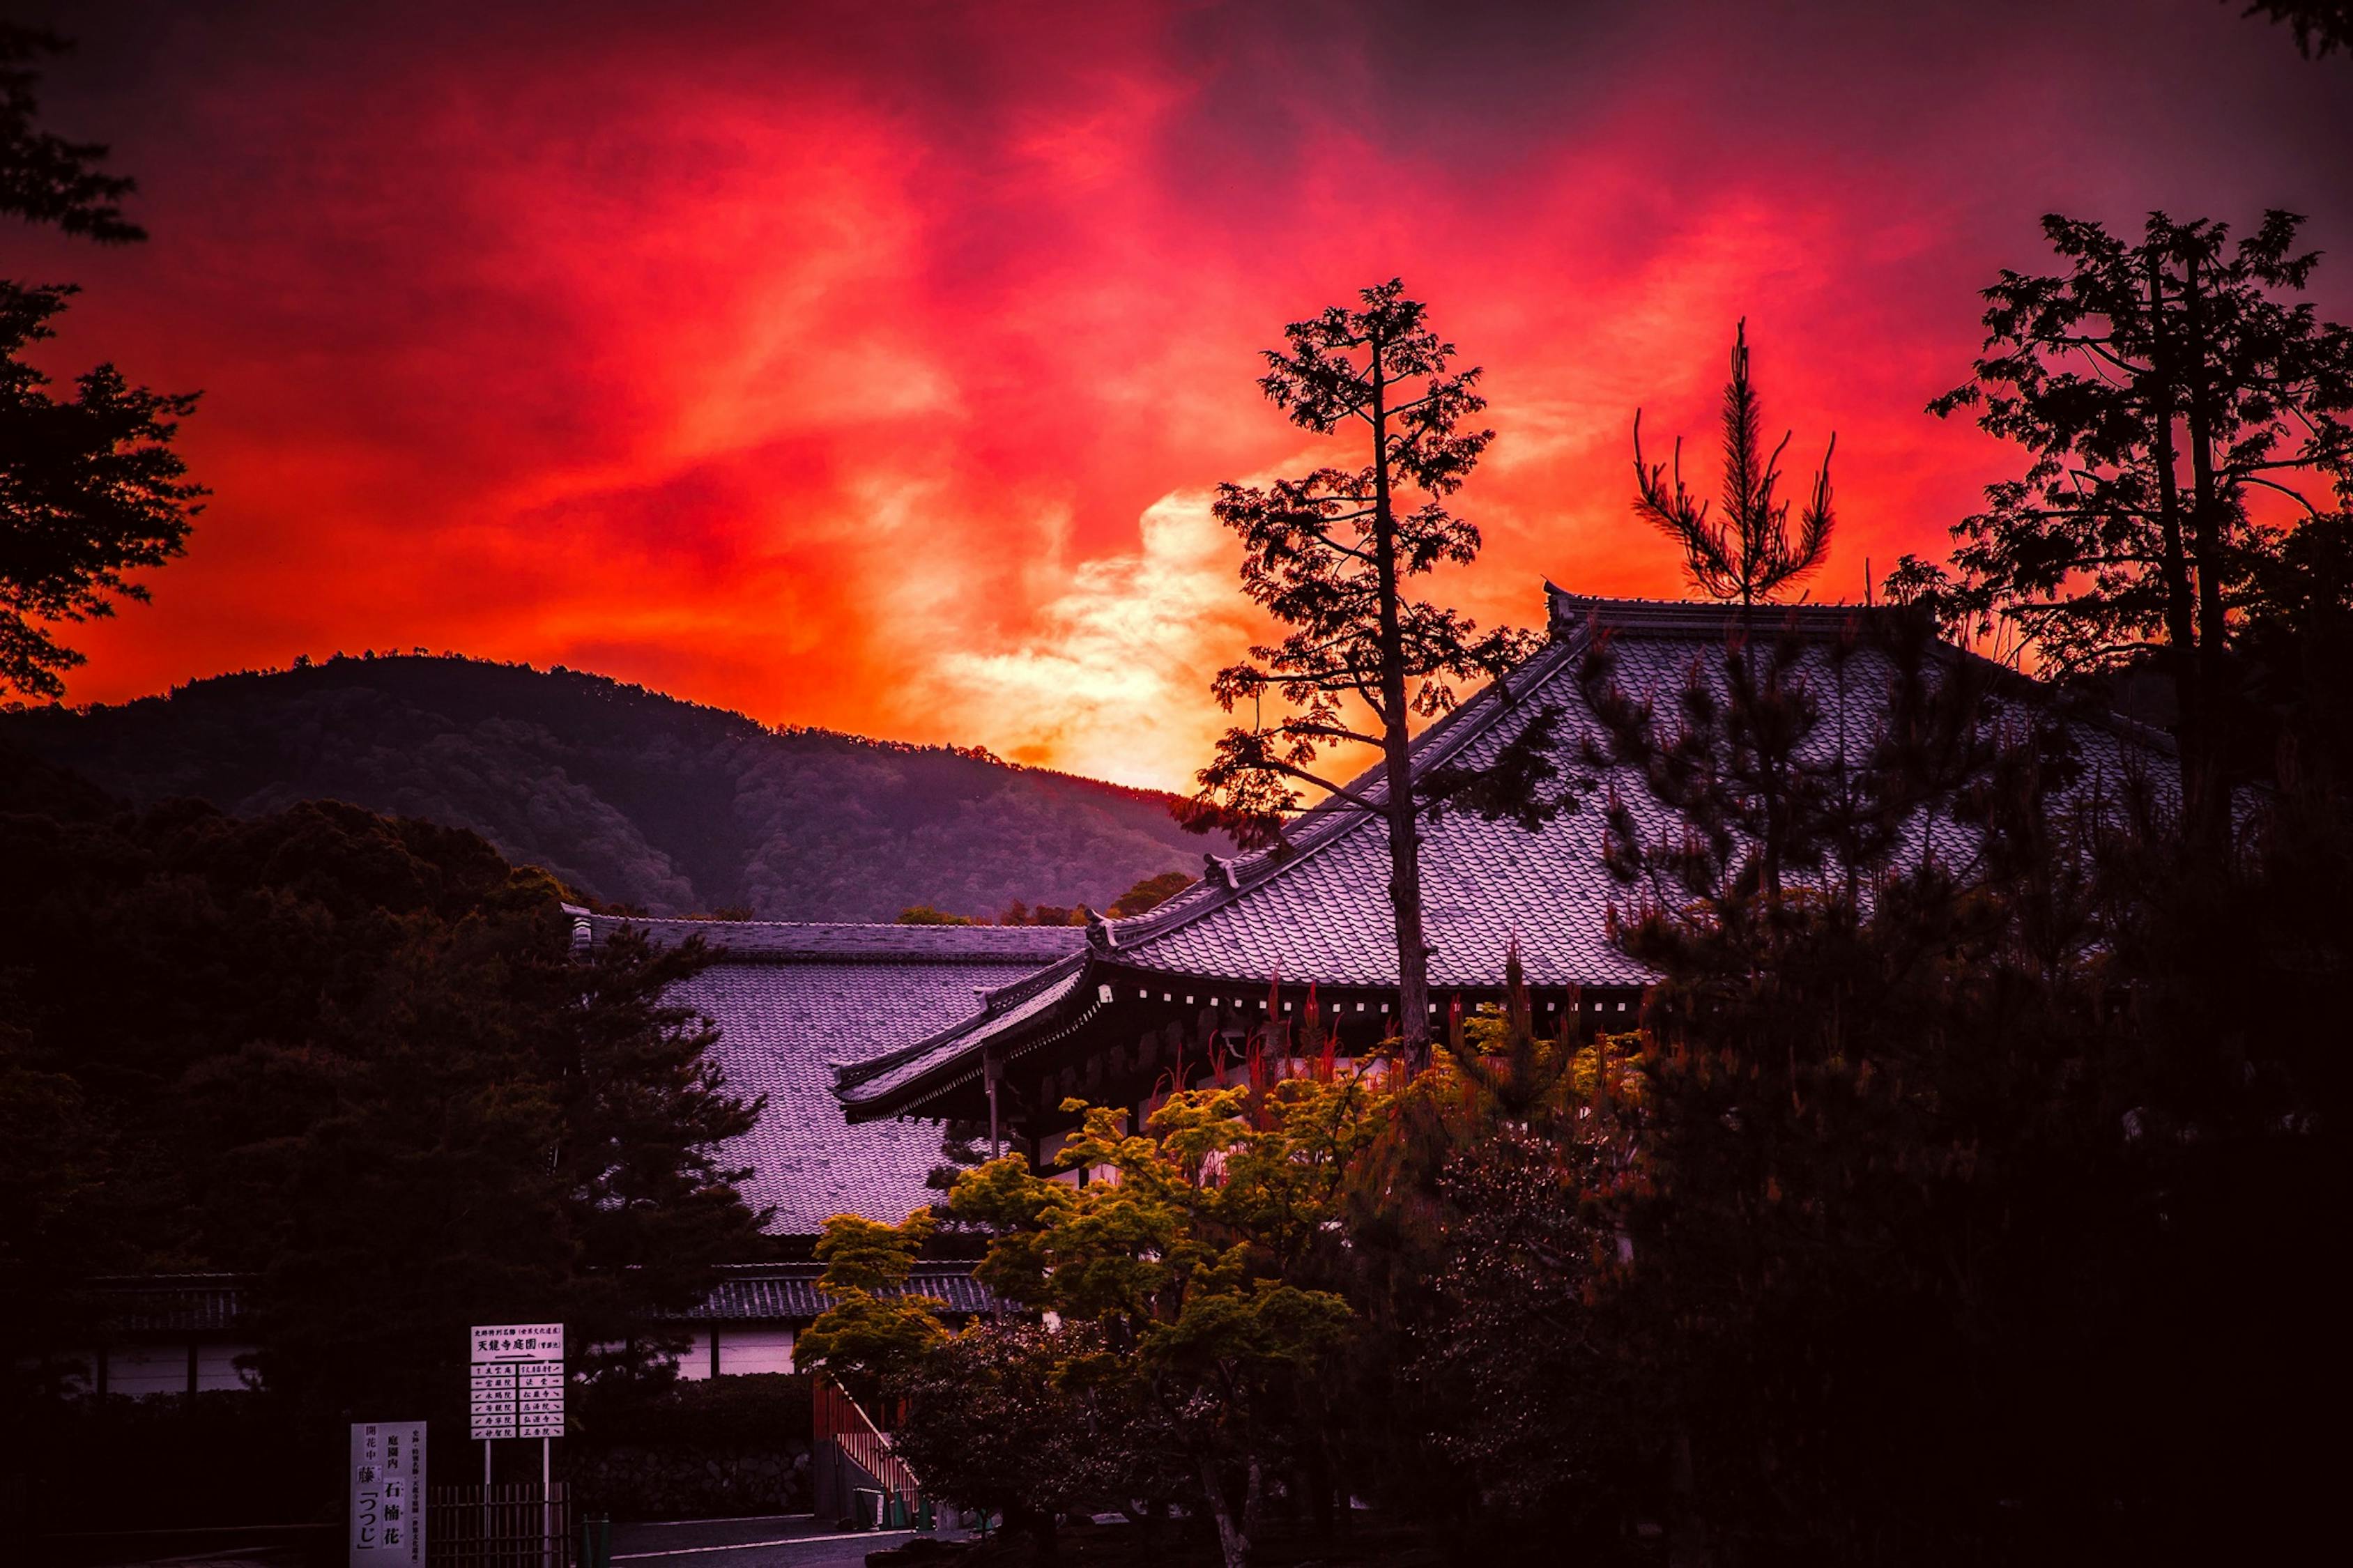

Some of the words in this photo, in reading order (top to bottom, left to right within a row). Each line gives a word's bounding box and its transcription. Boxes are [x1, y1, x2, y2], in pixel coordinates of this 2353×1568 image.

[477, 1339, 537, 1351] 天龍寺庭園
[366, 1426, 376, 1460] 開花中
[388, 1436, 398, 1469] 庭園内
[358, 1466, 374, 1483] 藤
[357, 1492, 378, 1549] 「つつじ」
[384, 1482, 400, 1545] 石楠花
